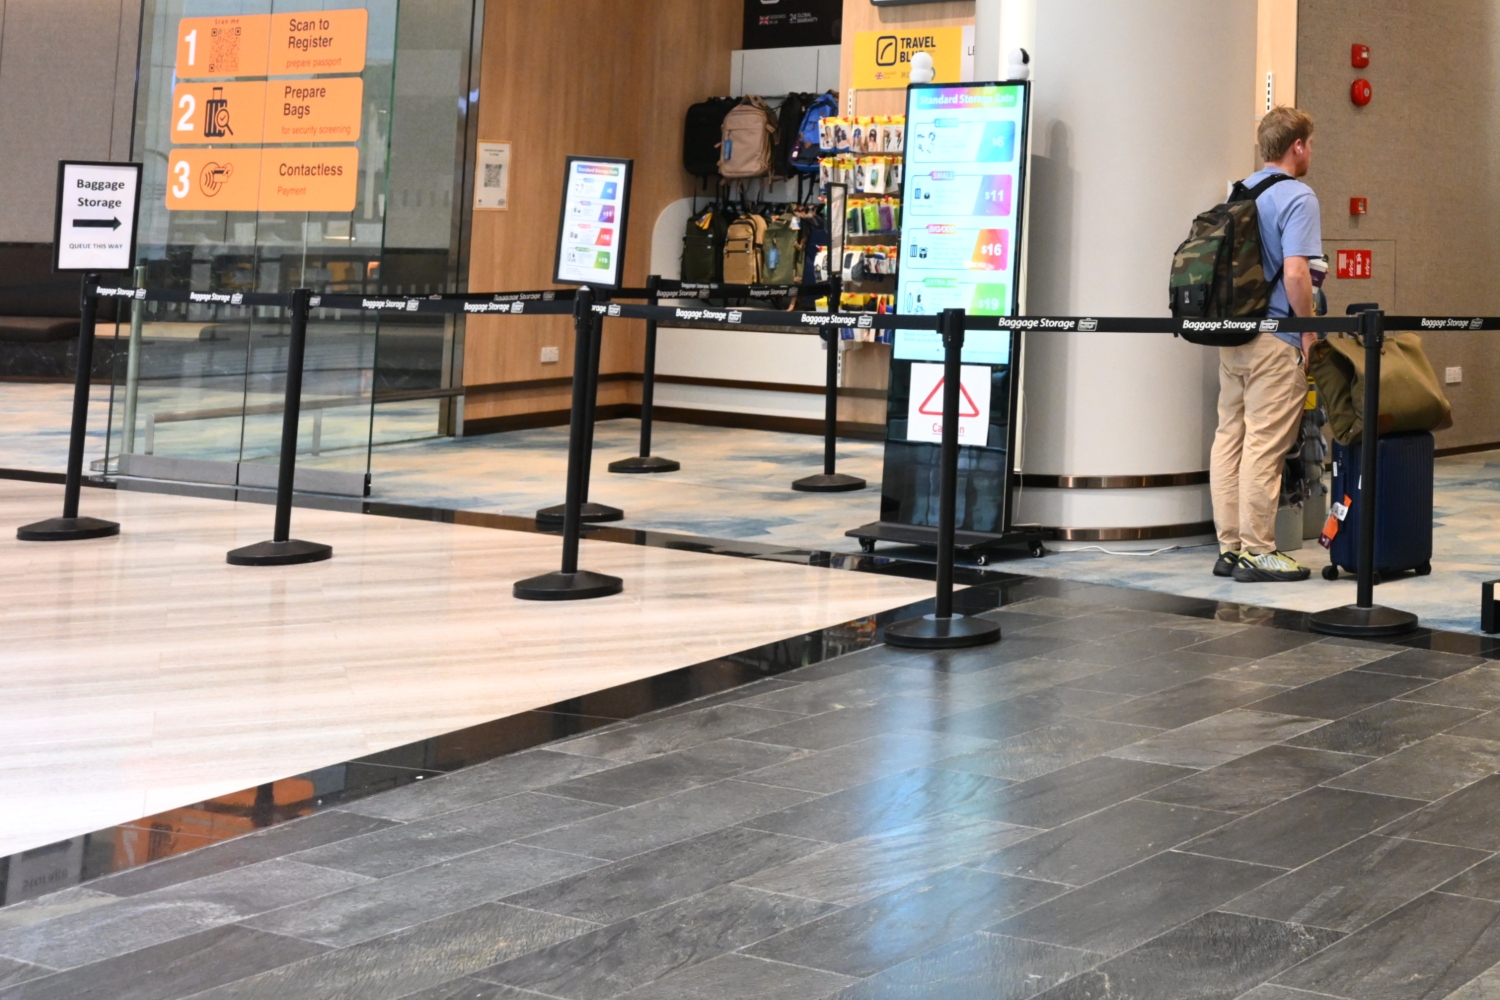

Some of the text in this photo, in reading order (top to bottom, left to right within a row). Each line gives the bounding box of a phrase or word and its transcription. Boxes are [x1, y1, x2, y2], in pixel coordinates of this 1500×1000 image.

[289, 18, 330, 32] Scan to
[184, 29, 197, 66] 1
[288, 35, 333, 51] Register
[900, 36, 936, 49] TRAVEL
[286, 57, 342, 68] prepare passport
[284, 85, 326, 101] Prepare
[920, 93, 1015, 105] Standard Storage Rate
[176, 93, 196, 131] 2
[283, 103, 311, 119] Bags
[281, 125, 351, 136] for security screening
[279, 162, 343, 177] Contactless
[932, 171, 954, 180] SMALL
[76, 179, 125, 192] Baggage
[172, 160, 191, 199] 3
[277, 186, 307, 197] Payment
[984, 189, 1004, 202] $11
[77, 197, 122, 209] Storage
[981, 243, 1003, 256] $16
[96, 286, 135, 297] Baggage Storage
[190, 292, 231, 302] Baggage Storage
[656, 289, 679, 297] Baggage
[750, 289, 770, 297] Baggage
[362, 298, 406, 309] Baggage Storage
[464, 302, 510, 312] Baggage Storage
[978, 297, 999, 310] $19
[675, 308, 727, 320] Baggage Storage
[801, 313, 856, 326] Baggage Storage
[998, 317, 1039, 329] Baggage
[1040, 317, 1076, 330] Storage
[1182, 319, 1222, 332] Baggage
[1222, 320, 1257, 331] Storage
[1420, 318, 1469, 328] Baggage Storage
